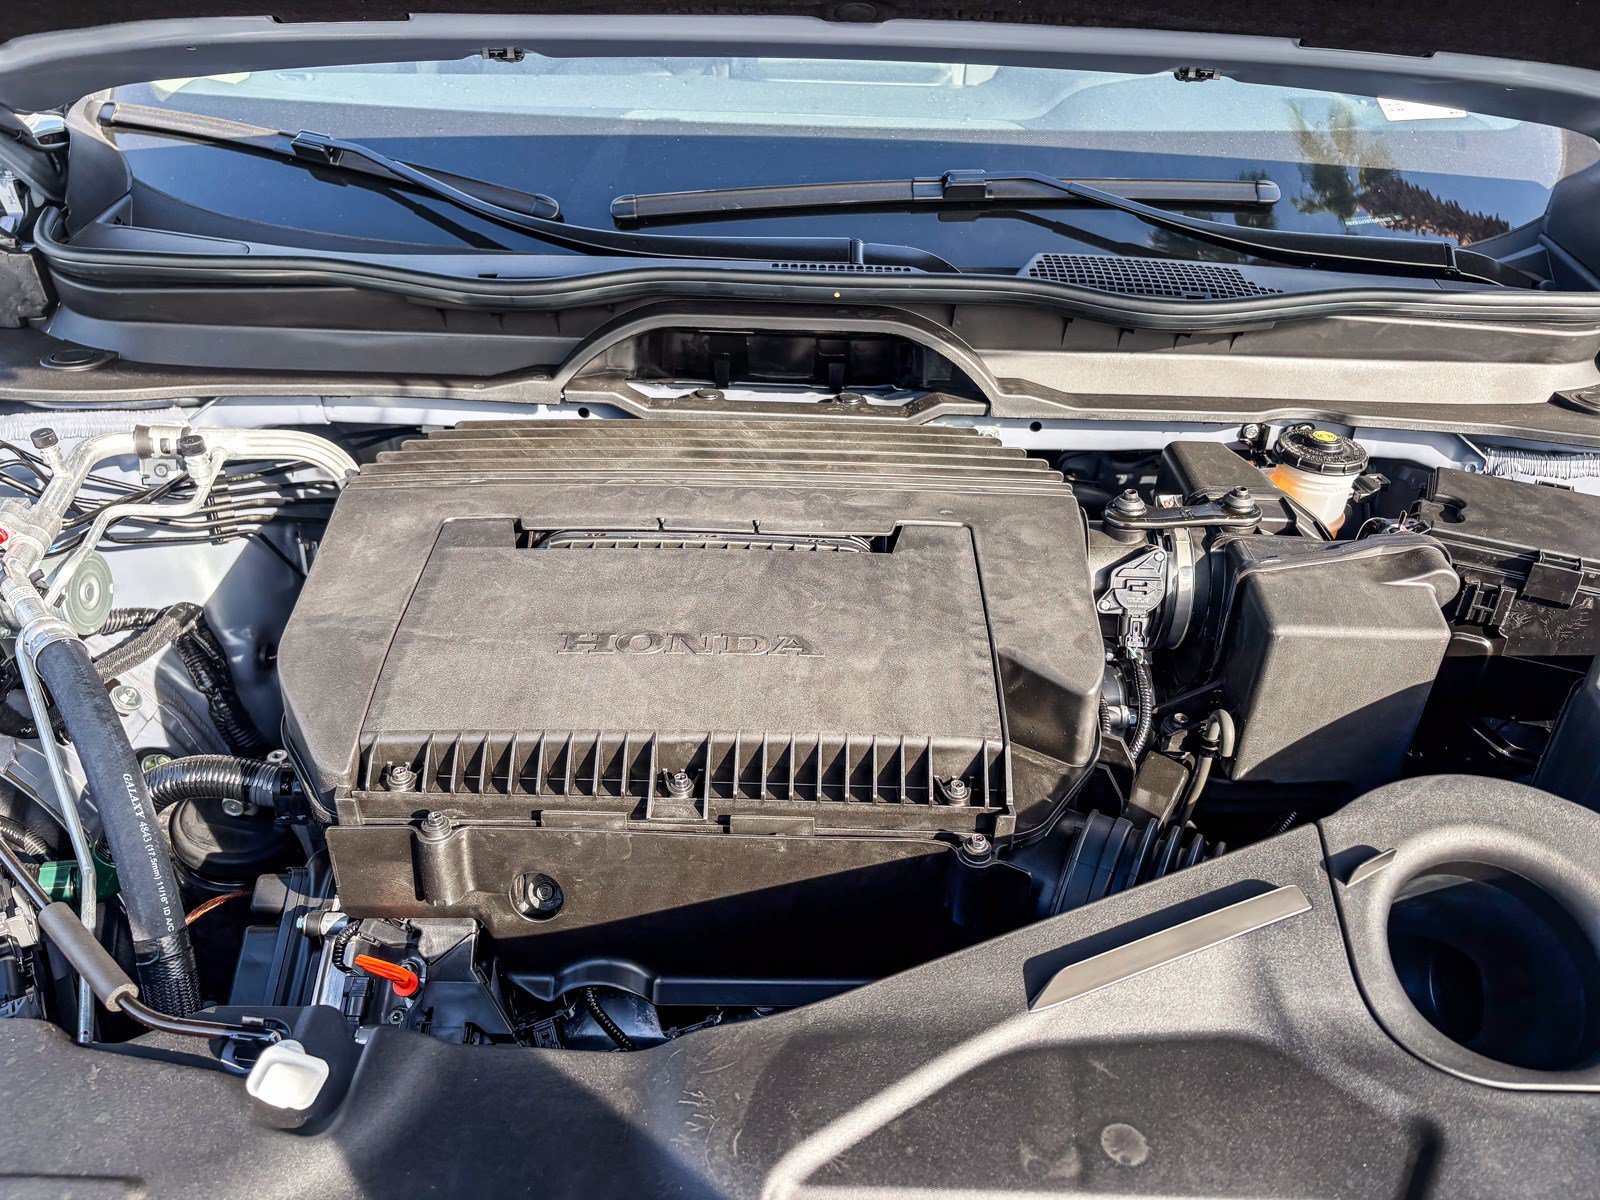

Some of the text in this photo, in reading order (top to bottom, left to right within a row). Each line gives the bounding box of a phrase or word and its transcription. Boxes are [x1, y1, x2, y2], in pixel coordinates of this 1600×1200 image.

[557, 632, 825, 658] HONDA
[123, 773, 146, 819] GALAXY
[139, 821, 153, 843] 4843
[144, 844, 162, 880] (17.5mm)
[163, 906, 171, 916] ID
[165, 917, 175, 932] A/C
